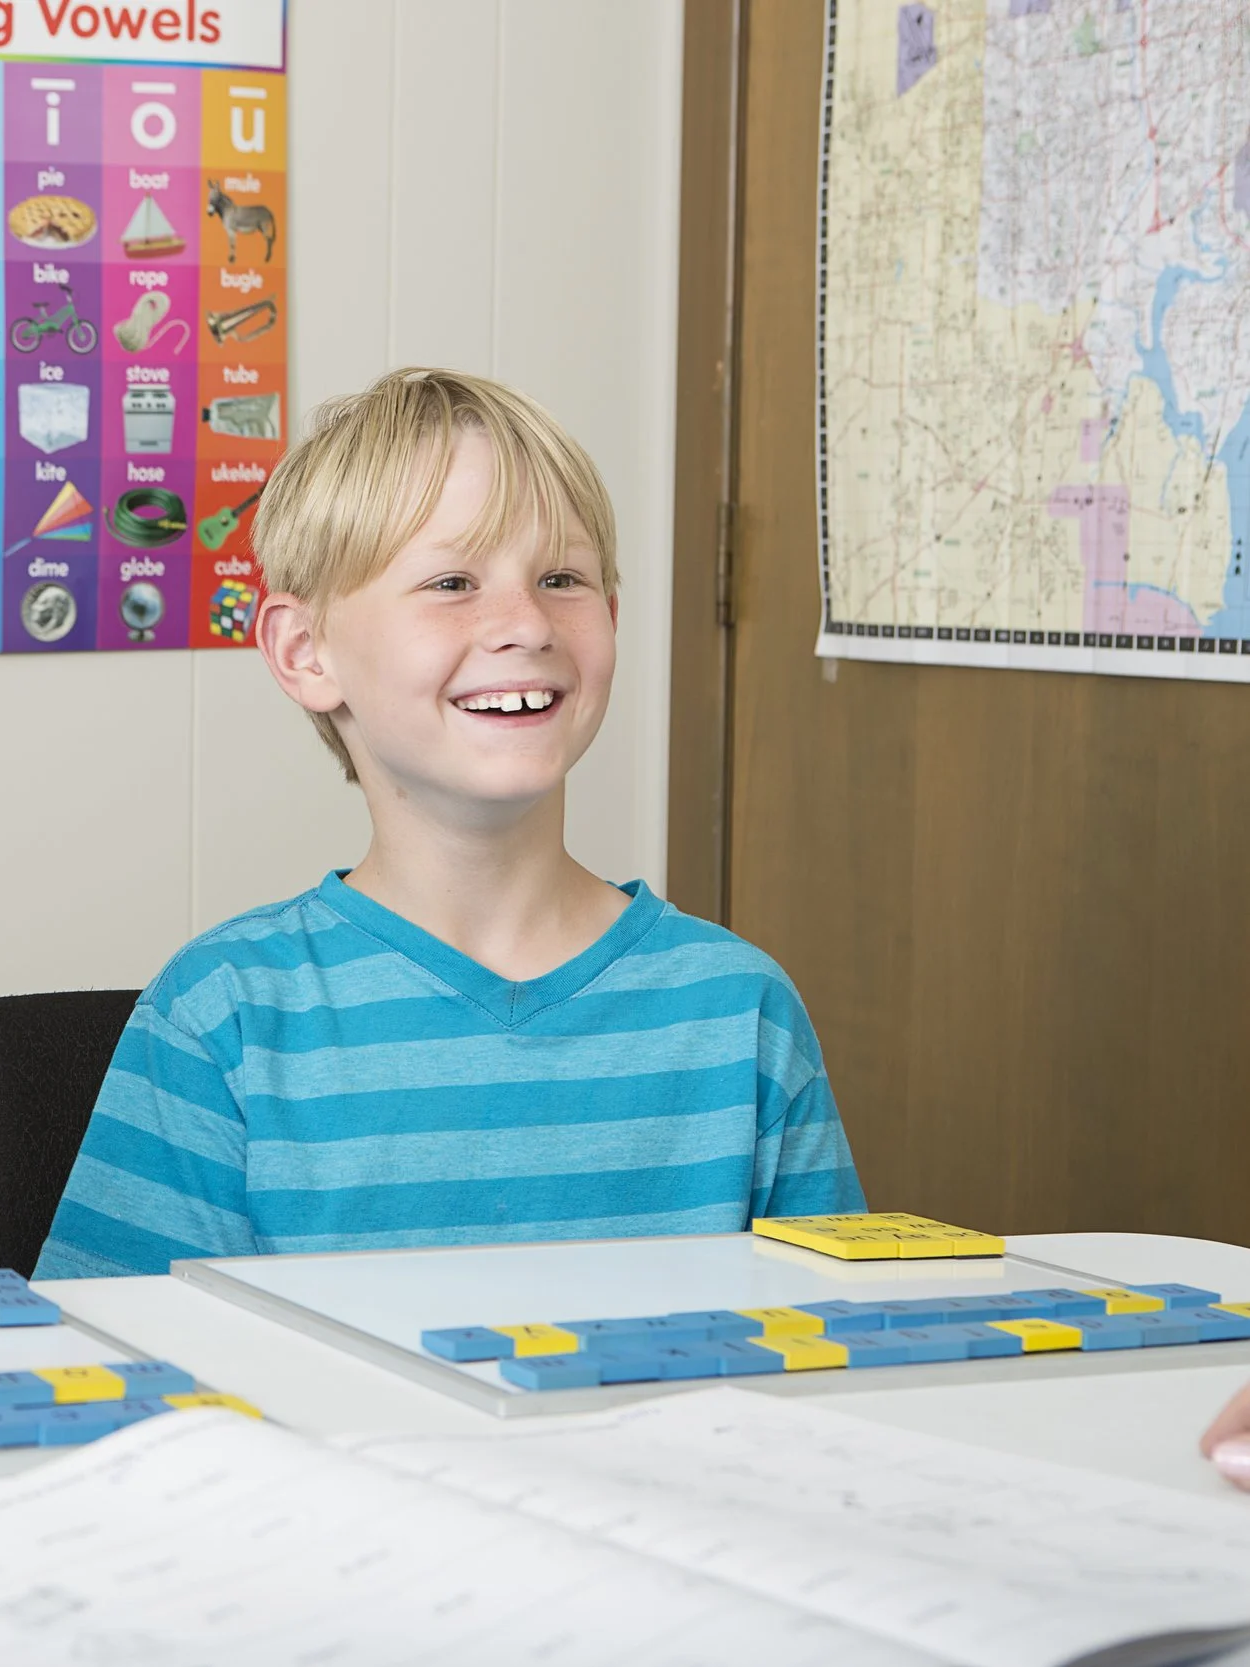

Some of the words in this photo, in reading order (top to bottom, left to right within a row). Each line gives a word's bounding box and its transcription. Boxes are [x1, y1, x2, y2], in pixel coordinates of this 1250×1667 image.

[38, 0, 222, 44] Vowels
[37, 168, 65, 190] pie
[129, 170, 169, 190] boat
[224, 174, 261, 194] mule
[33, 263, 70, 285] bike
[129, 268, 168, 290] rope
[220, 268, 263, 293] bugle
[39, 362, 64, 380] ice
[126, 364, 170, 382] stove
[223, 366, 259, 384] tube
[36, 463, 67, 482] kite
[127, 463, 165, 482] hose
[28, 560, 69, 578] dime
[120, 560, 165, 581] globe
[214, 555, 252, 576] cube
